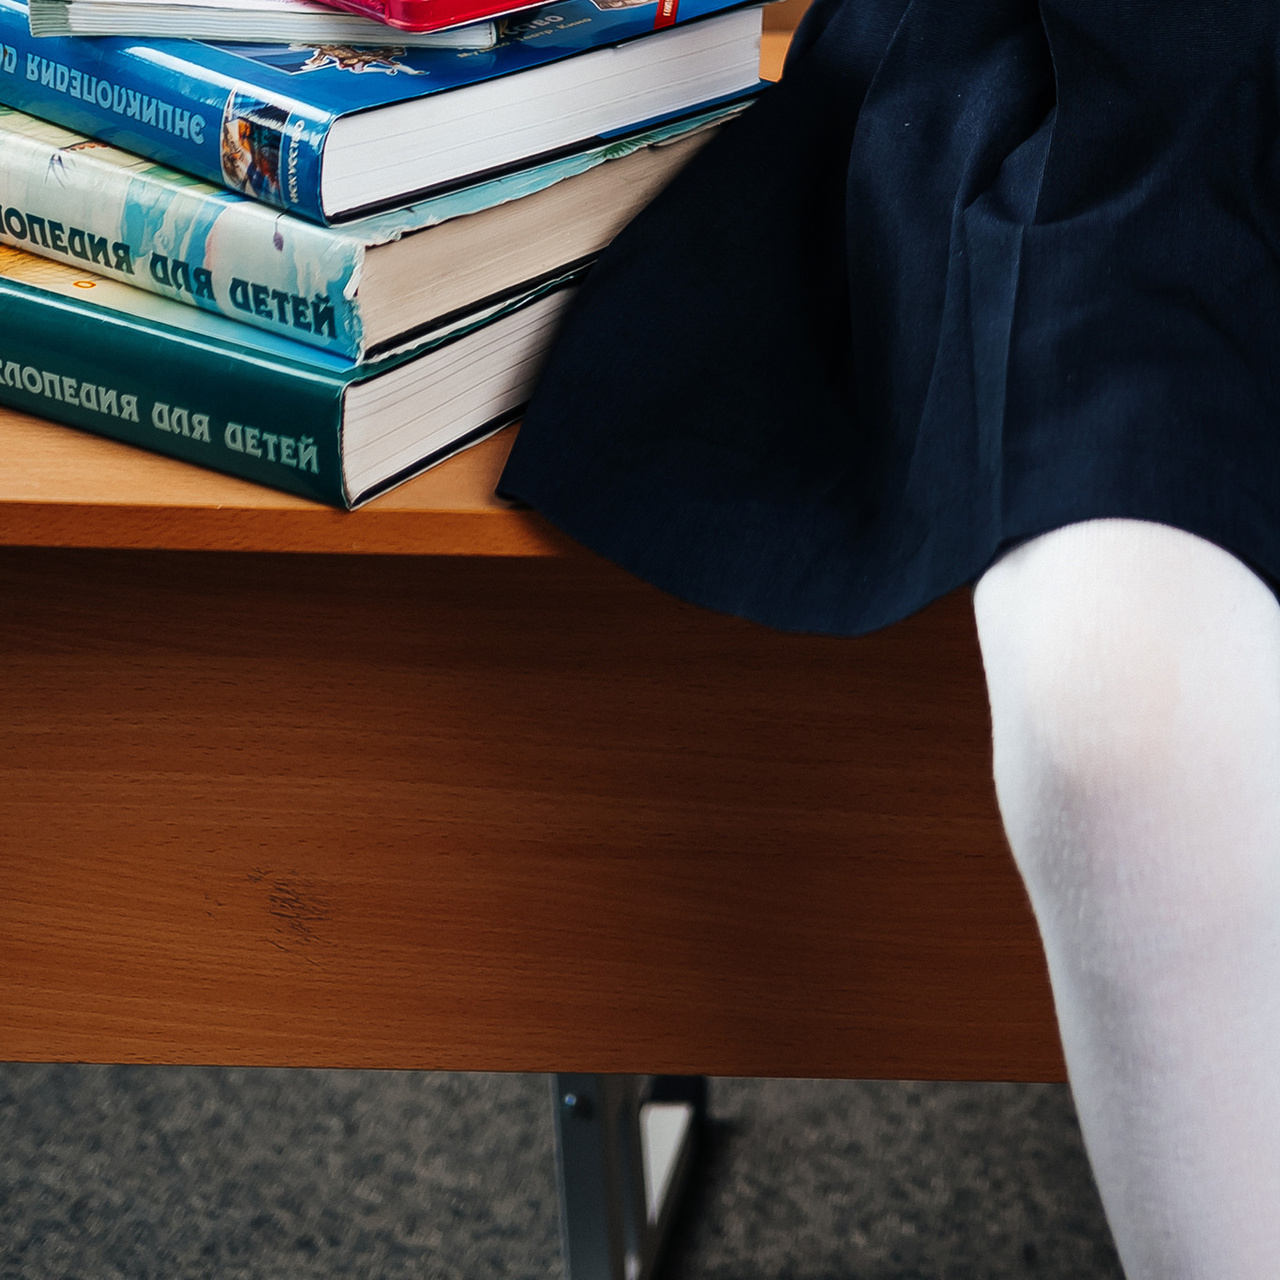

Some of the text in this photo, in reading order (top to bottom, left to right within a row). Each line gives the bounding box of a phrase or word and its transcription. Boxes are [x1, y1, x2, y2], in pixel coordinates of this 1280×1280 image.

[0, 42, 207, 146] Д ЭНЦИКЛОПЕДИЯ
[150, 251, 217, 301] ДЛЯ
[229, 276, 338, 340] ДЕТЕЙ
[151, 400, 212, 444] ДЛЯ
[224, 420, 321, 476] ДЕТЕЙ
